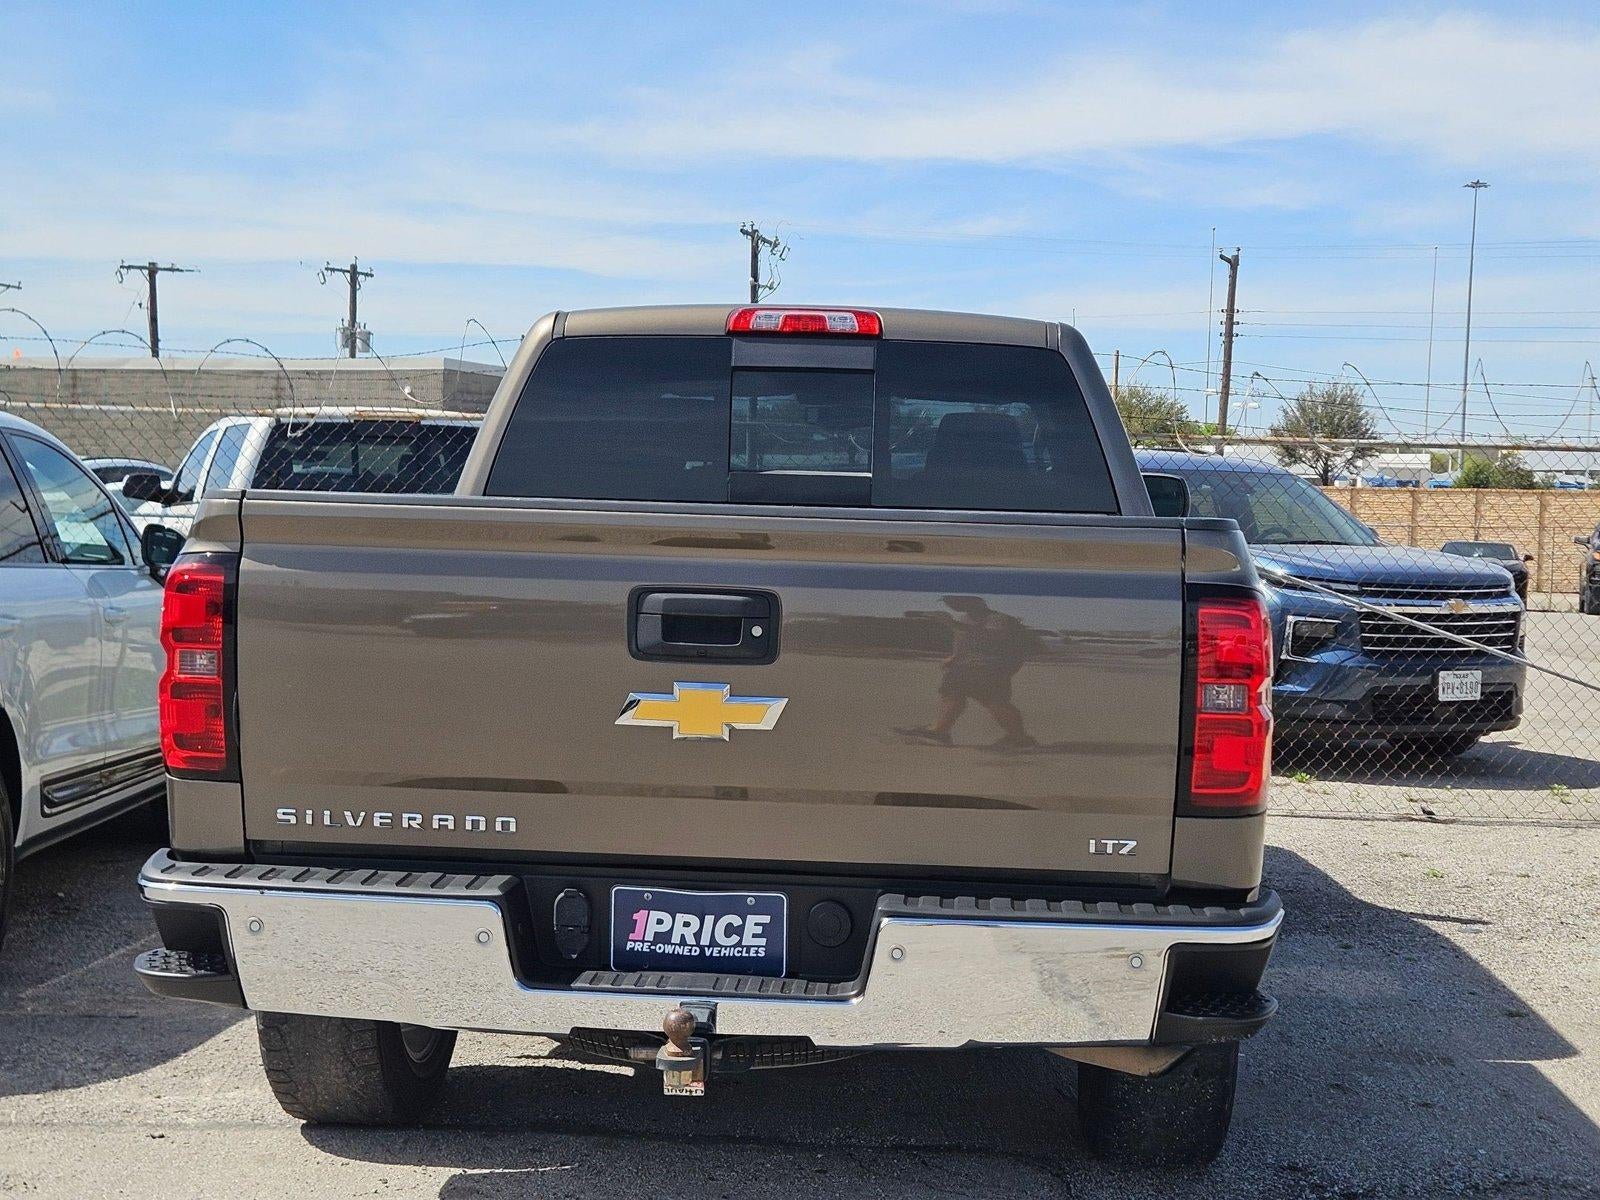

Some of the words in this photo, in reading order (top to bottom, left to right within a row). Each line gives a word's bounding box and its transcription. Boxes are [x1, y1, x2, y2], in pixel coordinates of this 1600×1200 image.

[276, 808, 517, 833] SILVERADO
[1089, 839, 1138, 855] LTZ
[628, 909, 771, 946] 1PRICE
[626, 941, 700, 956] PRE-OWNED
[705, 947, 766, 957] VEHICLES
